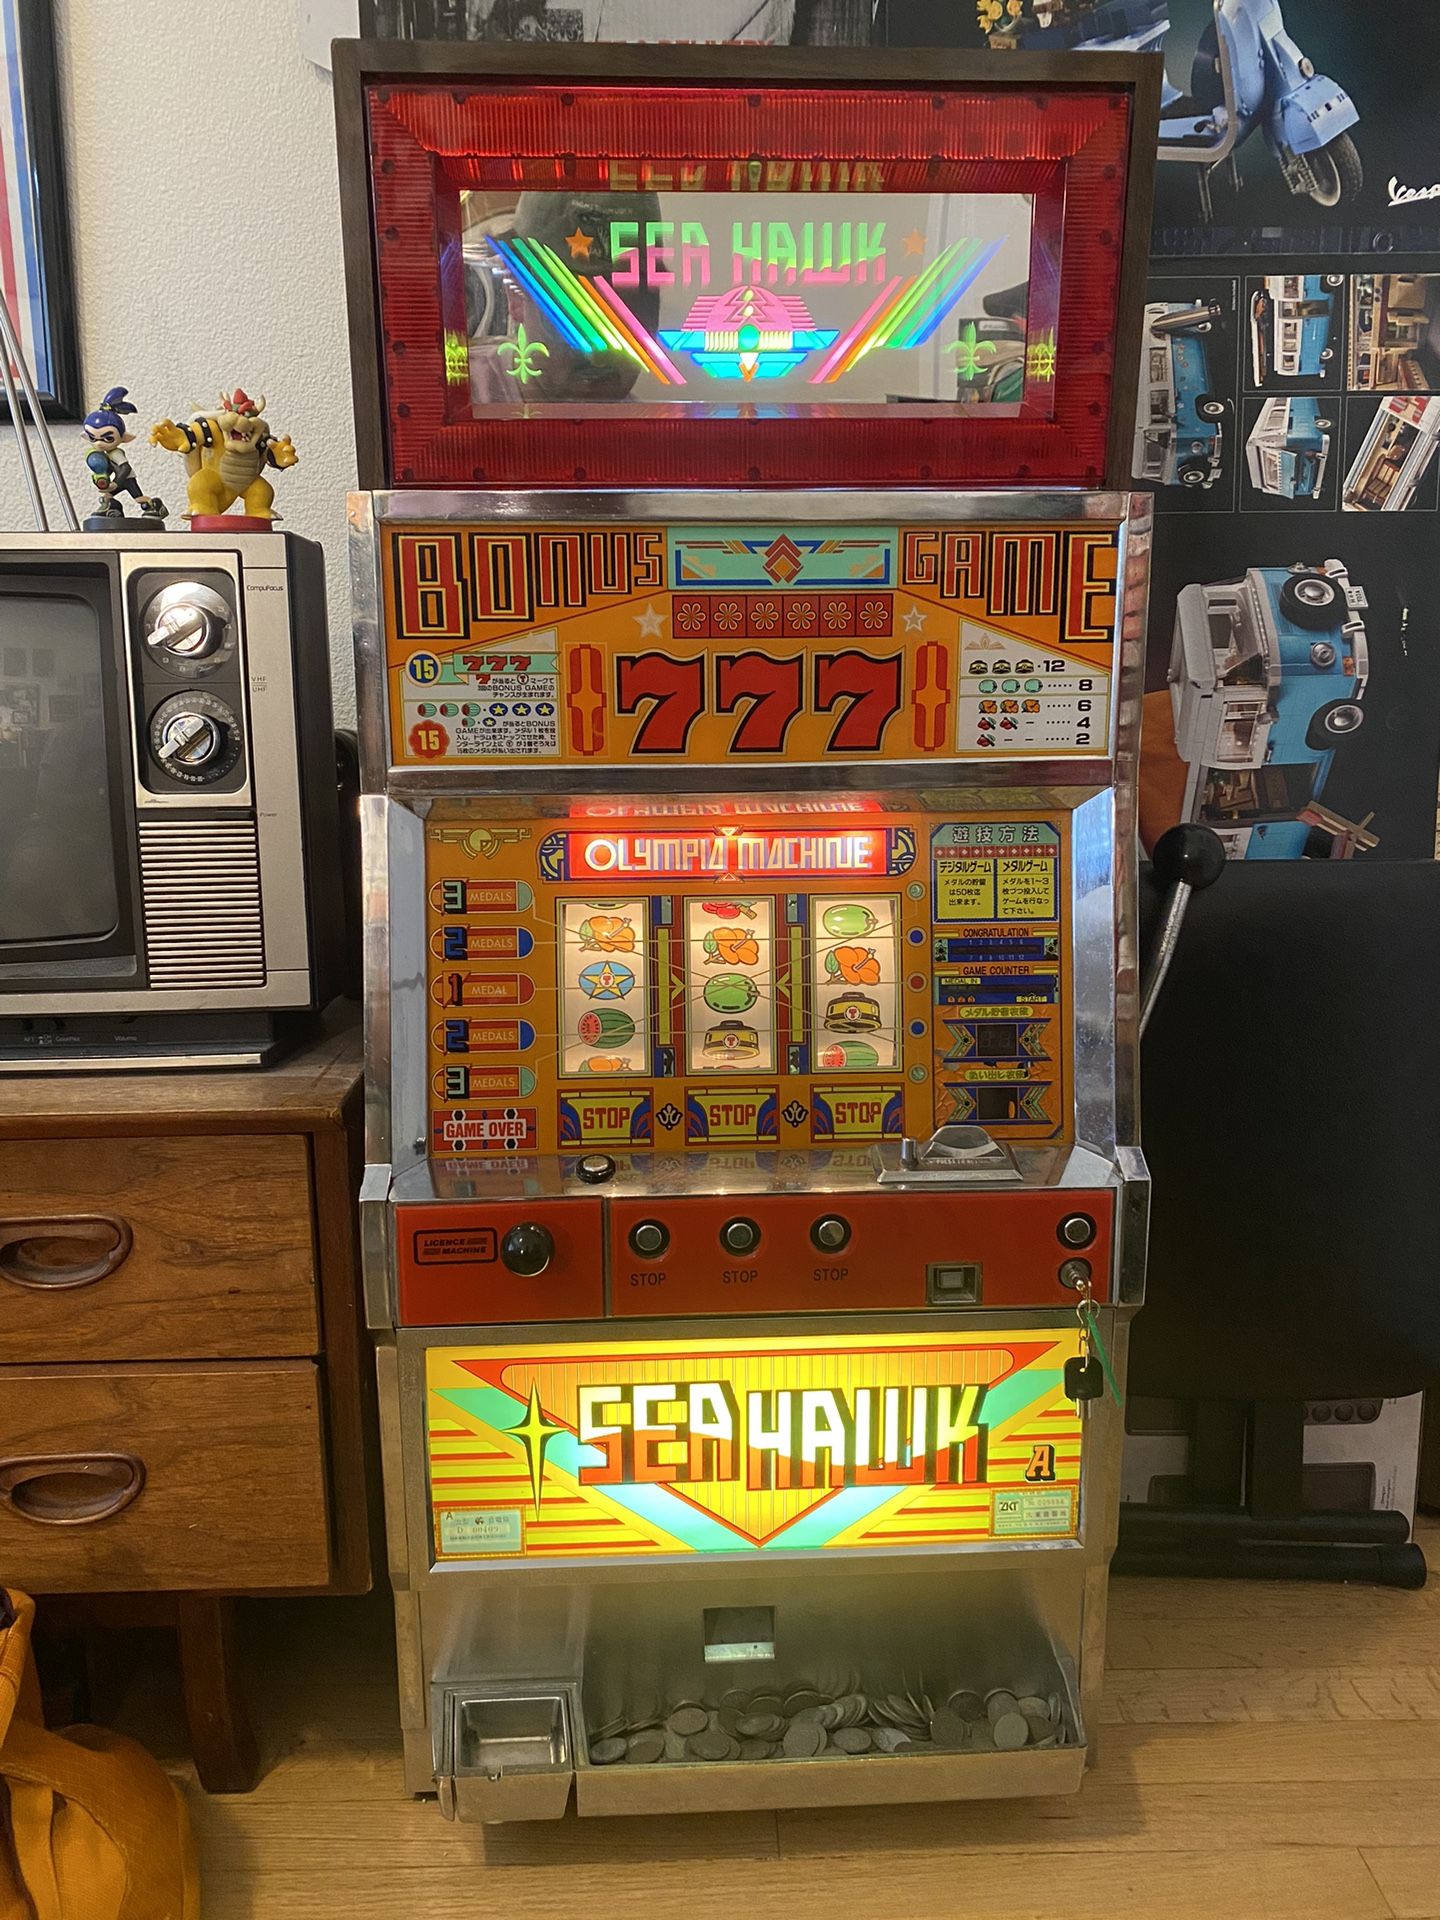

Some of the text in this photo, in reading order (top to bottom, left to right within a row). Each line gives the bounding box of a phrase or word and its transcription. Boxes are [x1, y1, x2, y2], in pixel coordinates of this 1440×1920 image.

[610, 222, 886, 286] SEA HAWK
[392, 531, 1119, 643] BONUS GAME
[413, 659, 434, 680] 15
[1043, 660, 1066, 673] 12
[1079, 679, 1093, 692] 8
[1077, 700, 1092, 713] 6
[1076, 716, 1091, 729] 4
[418, 730, 439, 751] 15
[1075, 733, 1091, 745] 2
[953, 826, 1040, 843] 遊技方法
[584, 836, 873, 872] OLYMPIA MACHINE
[940, 861, 991, 873] デジタルゲーム
[442, 879, 513, 914] 3 MEDALS
[963, 928, 1030, 938] CONGRATULATION
[443, 926, 514, 960] 2 MEDALS
[963, 965, 1030, 976] GAME COUNTER
[448, 972, 507, 1007] 1 MEDAL
[445, 1019, 515, 1053] 2 MEDALS
[445, 1065, 515, 1099] 3 MEDALS
[583, 1107, 631, 1130] STOP
[709, 1104, 757, 1127] STOP
[835, 1102, 882, 1125] STOP
[446, 1121, 524, 1139] GAME OVER
[424, 1238, 466, 1247] LICENCE
[442, 1246, 487, 1255] MACHINE
[630, 1272, 666, 1287] STOP
[722, 1269, 758, 1284] STOP
[813, 1267, 849, 1282] STOP
[577, 1381, 990, 1491] SEA HAWK
[1025, 1444, 1056, 1482] A
[446, 1511, 453, 1520] A
